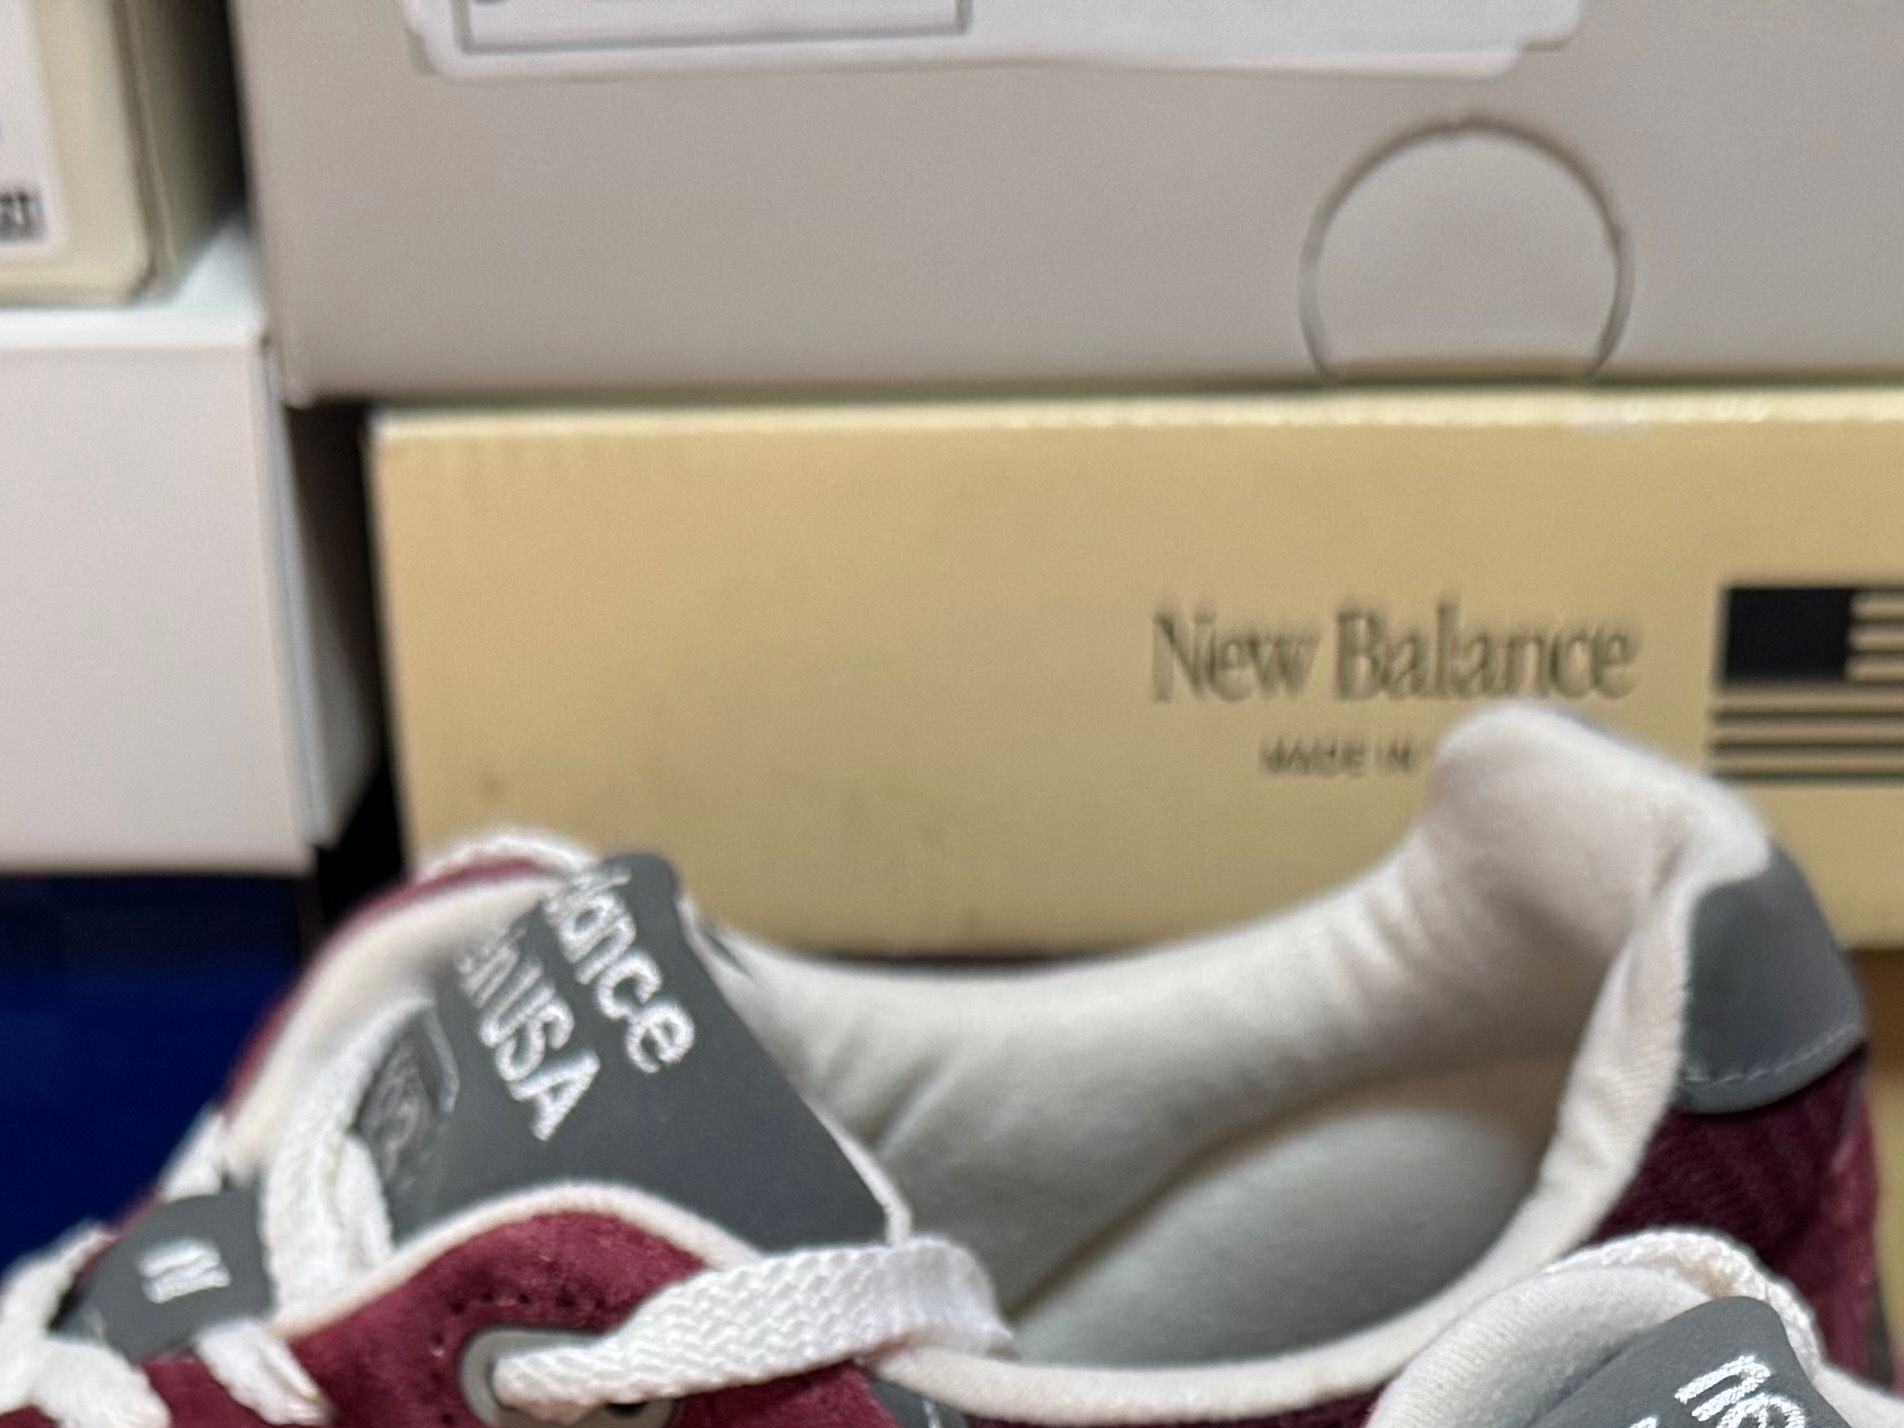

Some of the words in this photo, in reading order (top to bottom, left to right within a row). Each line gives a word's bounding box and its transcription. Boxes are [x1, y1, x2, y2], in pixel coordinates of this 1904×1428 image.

[1151, 608, 1316, 704] New
[1333, 598, 1644, 702] Balance
[476, 958, 602, 1142] USA
